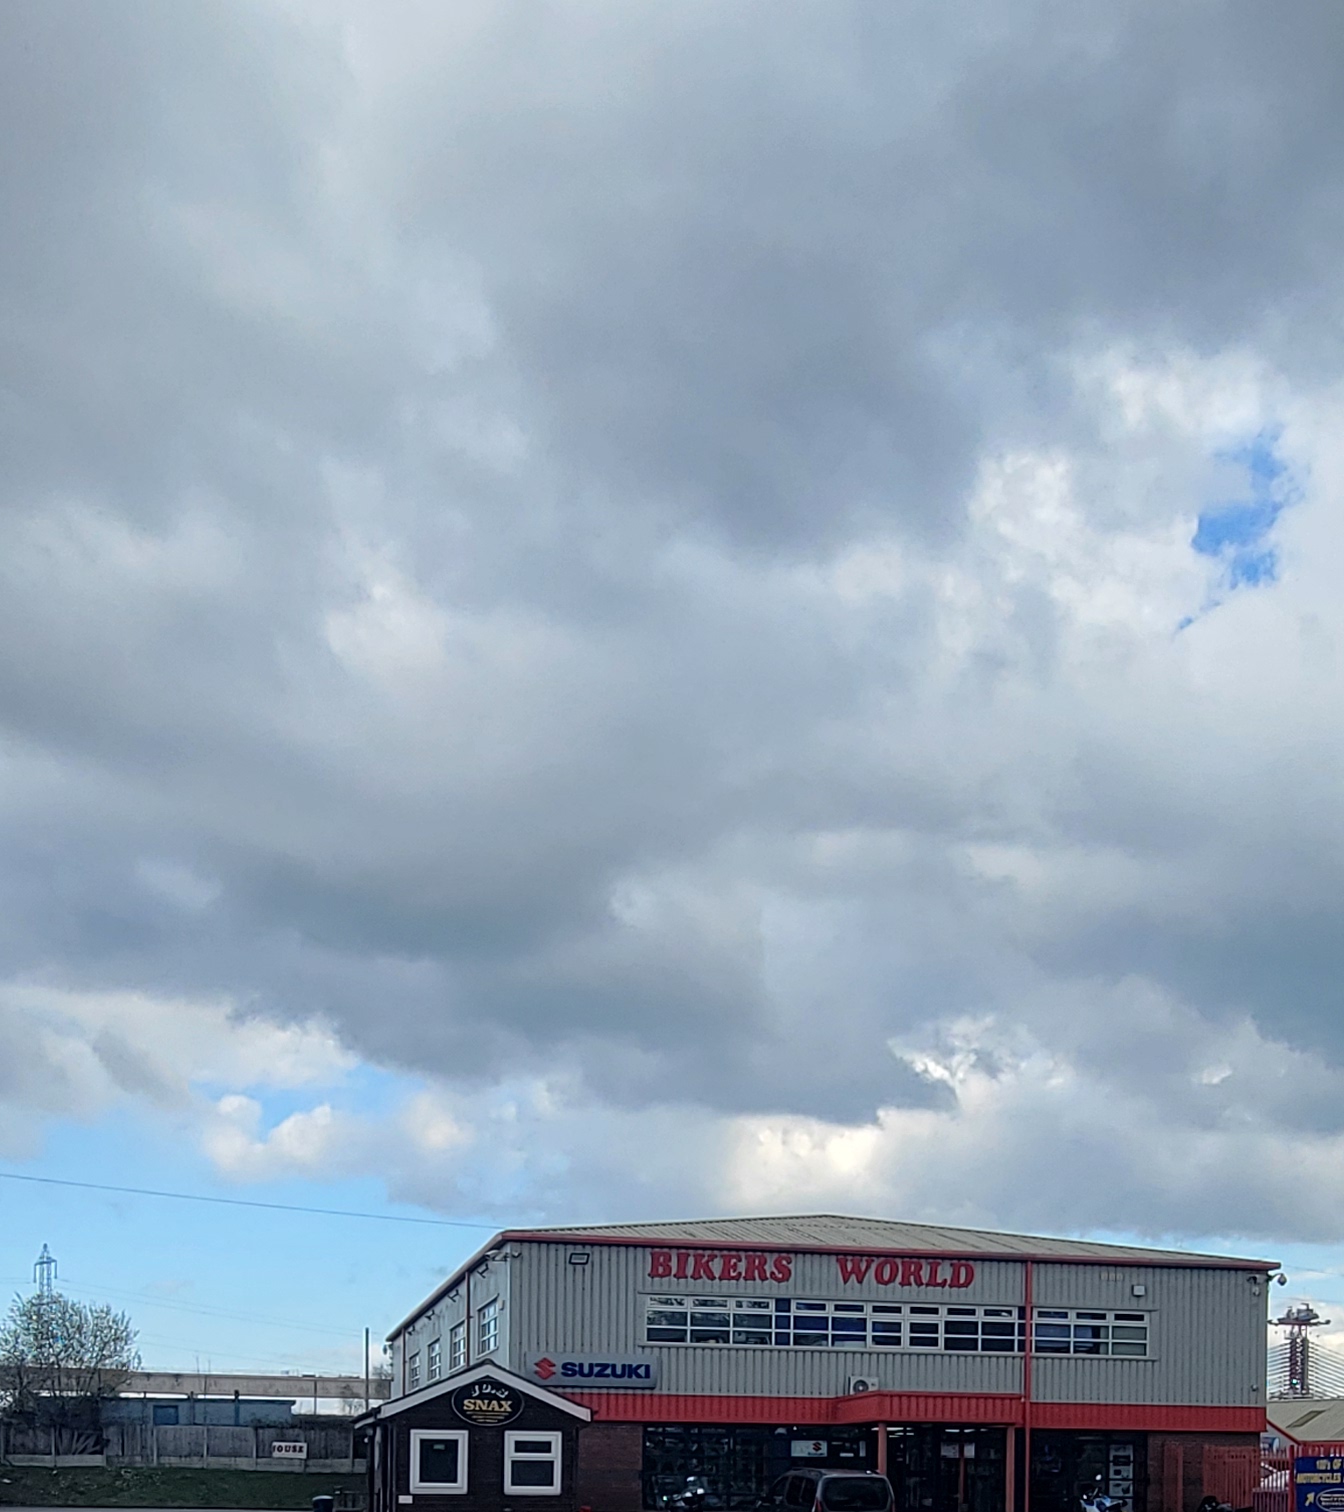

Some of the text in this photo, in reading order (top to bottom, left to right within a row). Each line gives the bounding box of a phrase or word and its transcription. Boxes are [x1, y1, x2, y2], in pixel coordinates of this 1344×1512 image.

[647, 1250, 975, 1290] BIKERS WORLD
[560, 1361, 651, 1379] SUZUKI
[463, 1399, 513, 1412] SNAX
[1296, 1472, 1341, 1484] MOTORCYCLES
